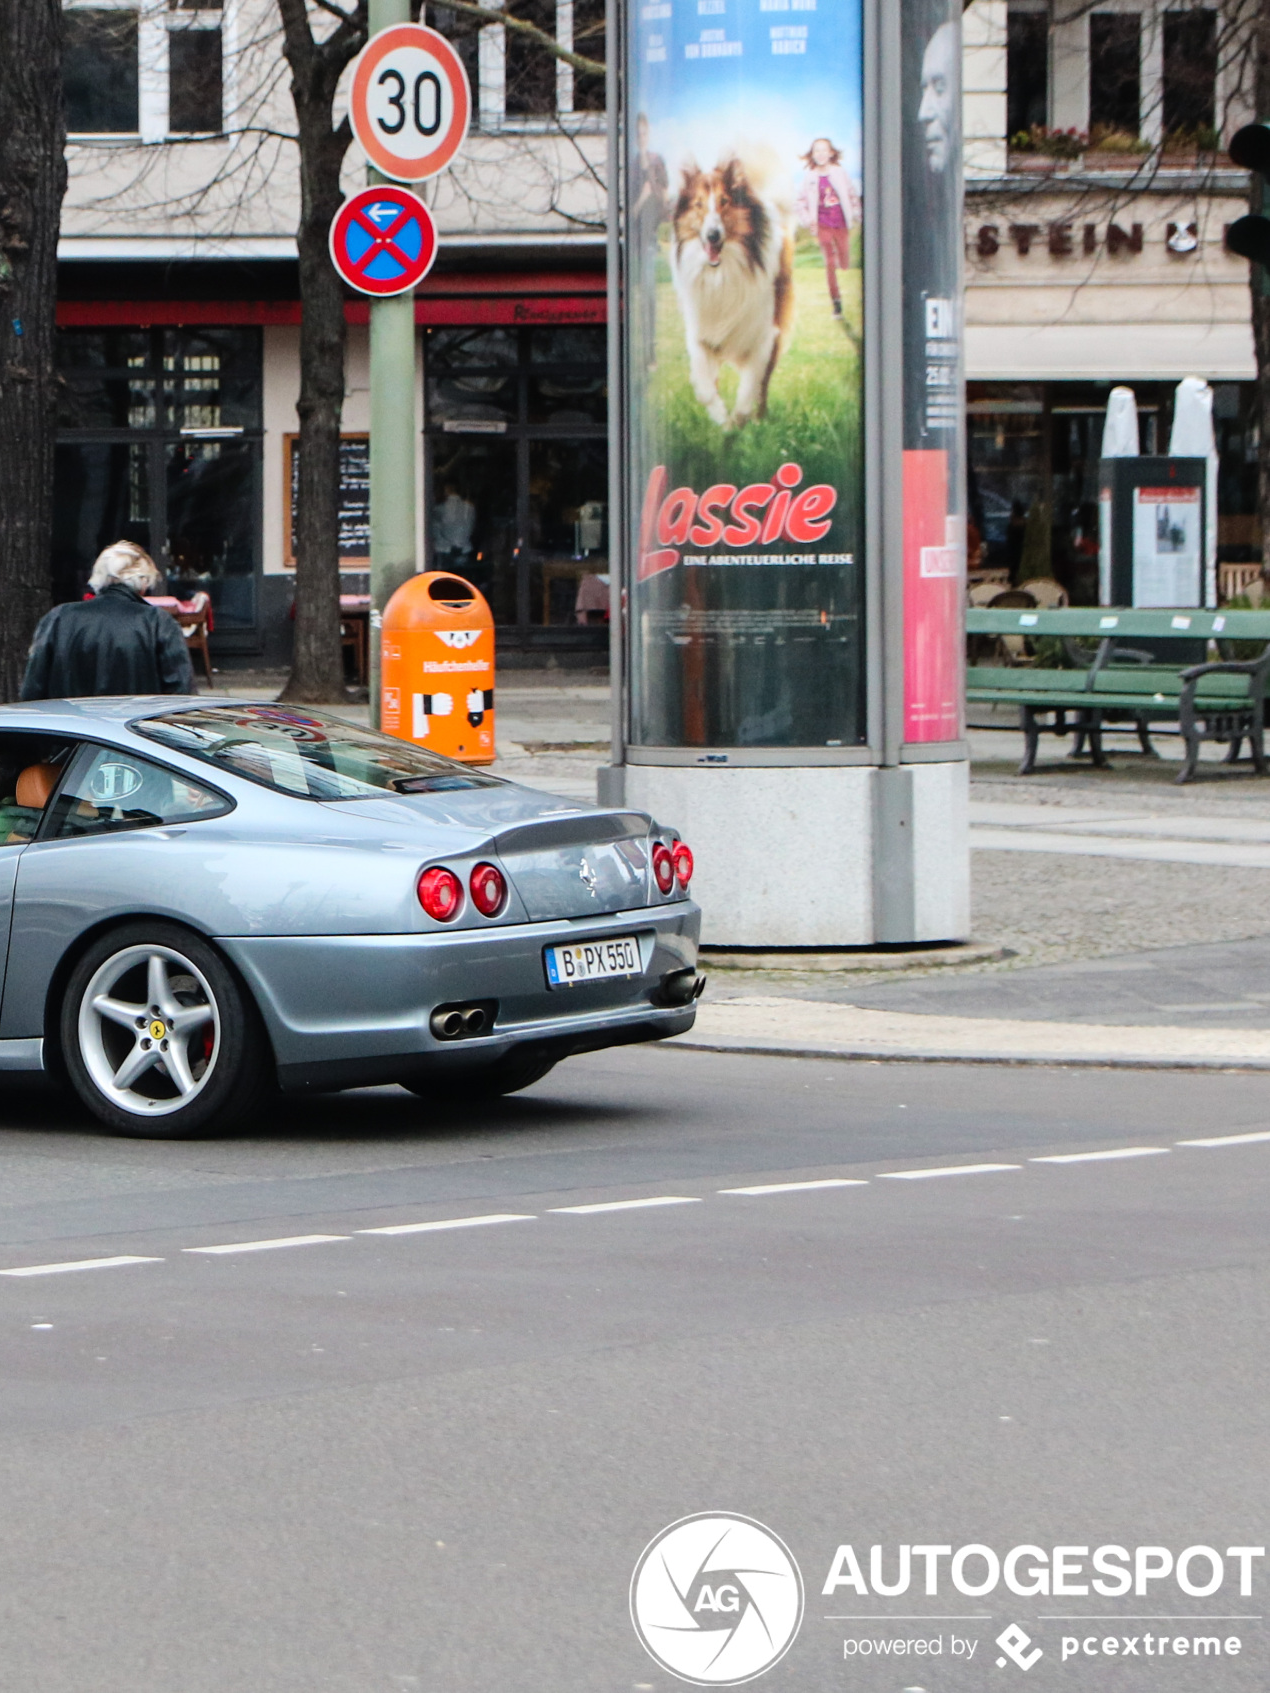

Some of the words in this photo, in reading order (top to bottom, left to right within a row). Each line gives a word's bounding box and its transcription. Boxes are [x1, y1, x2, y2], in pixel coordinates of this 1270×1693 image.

[377, 68, 442, 137] 30
[965, 222, 1143, 256] STEIN
[636, 462, 838, 584] Lassie
[683, 555, 708, 566] EINE
[709, 554, 817, 566] ABENTEUERLICHE
[819, 553, 854, 565] REISE
[562, 950, 575, 977] B
[584, 946, 606, 974] PX
[606, 942, 634, 971] 550
